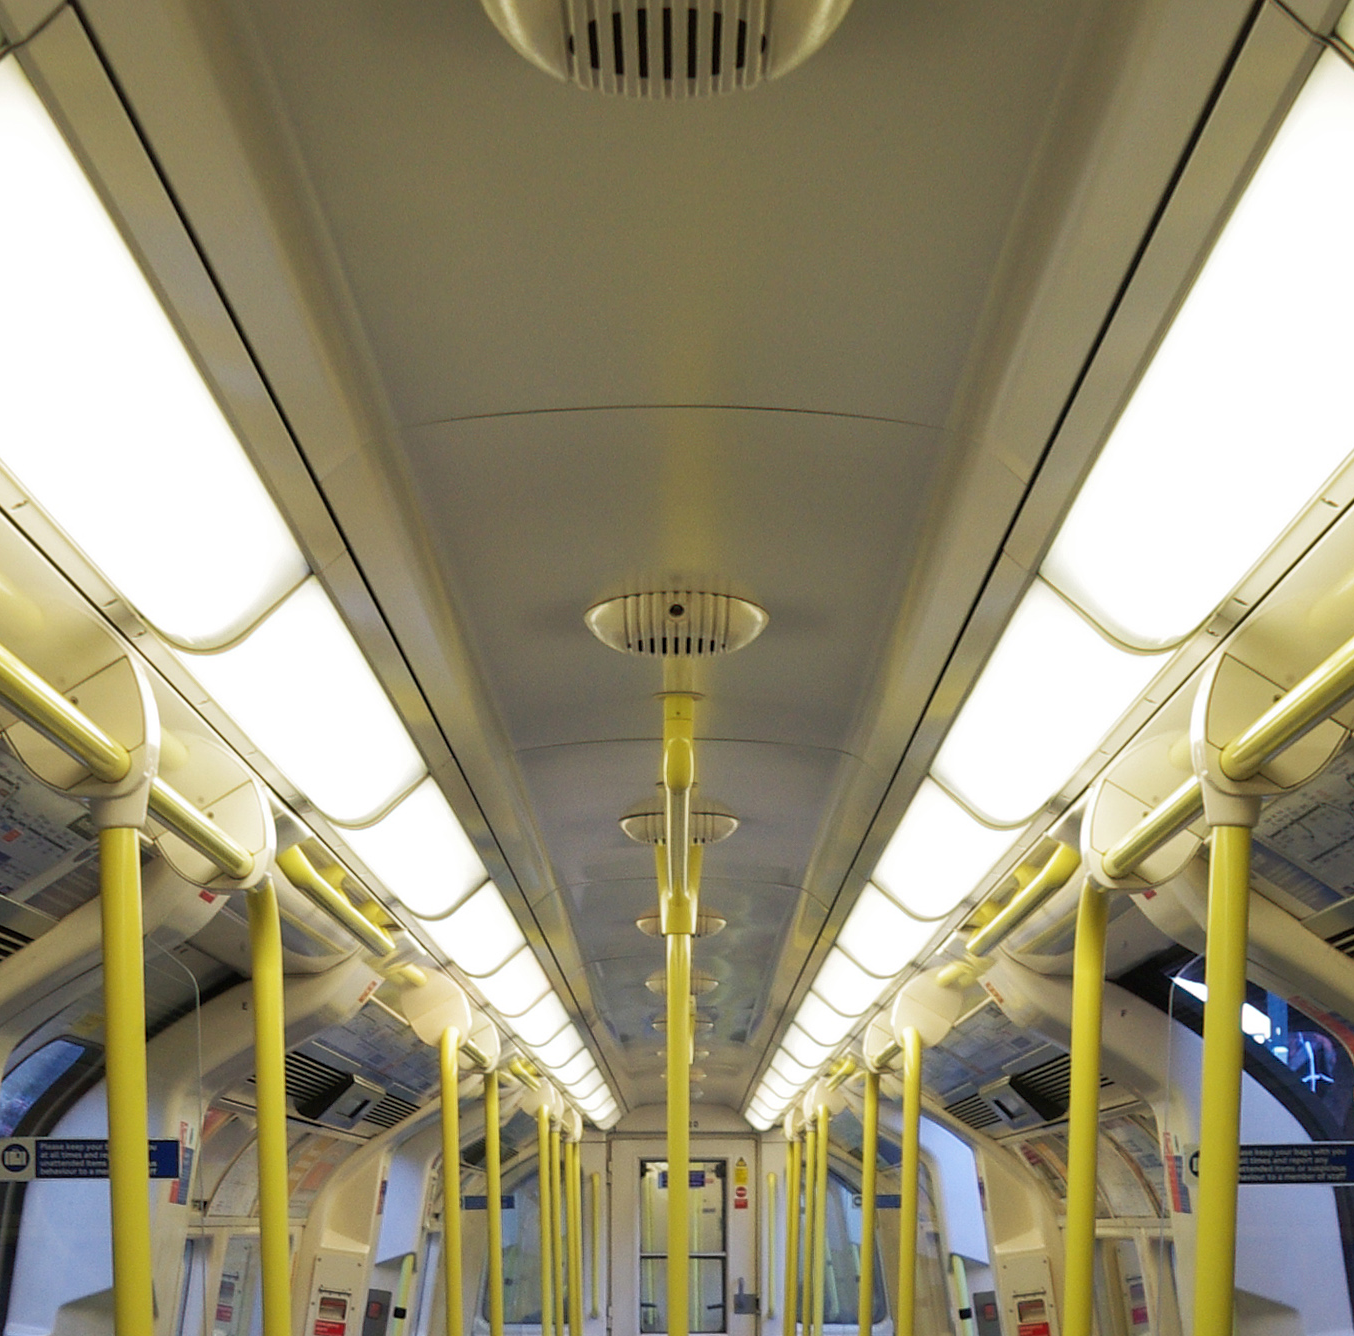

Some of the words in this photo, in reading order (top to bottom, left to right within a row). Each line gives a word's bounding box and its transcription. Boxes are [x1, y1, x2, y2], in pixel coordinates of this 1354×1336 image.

[40, 1143, 64, 1151] Please
[66, 1143, 85, 1151] keep
[86, 1144, 103, 1152] your
[1254, 1149, 1273, 1157] keep
[1275, 1150, 1292, 1158] your
[1293, 1149, 1312, 1158] bags
[40, 1160, 86, 1168] unattended
[1289, 1157, 1313, 1166] report
[40, 1168, 76, 1176] behaviour
[1308, 1165, 1346, 1173] suspicious
